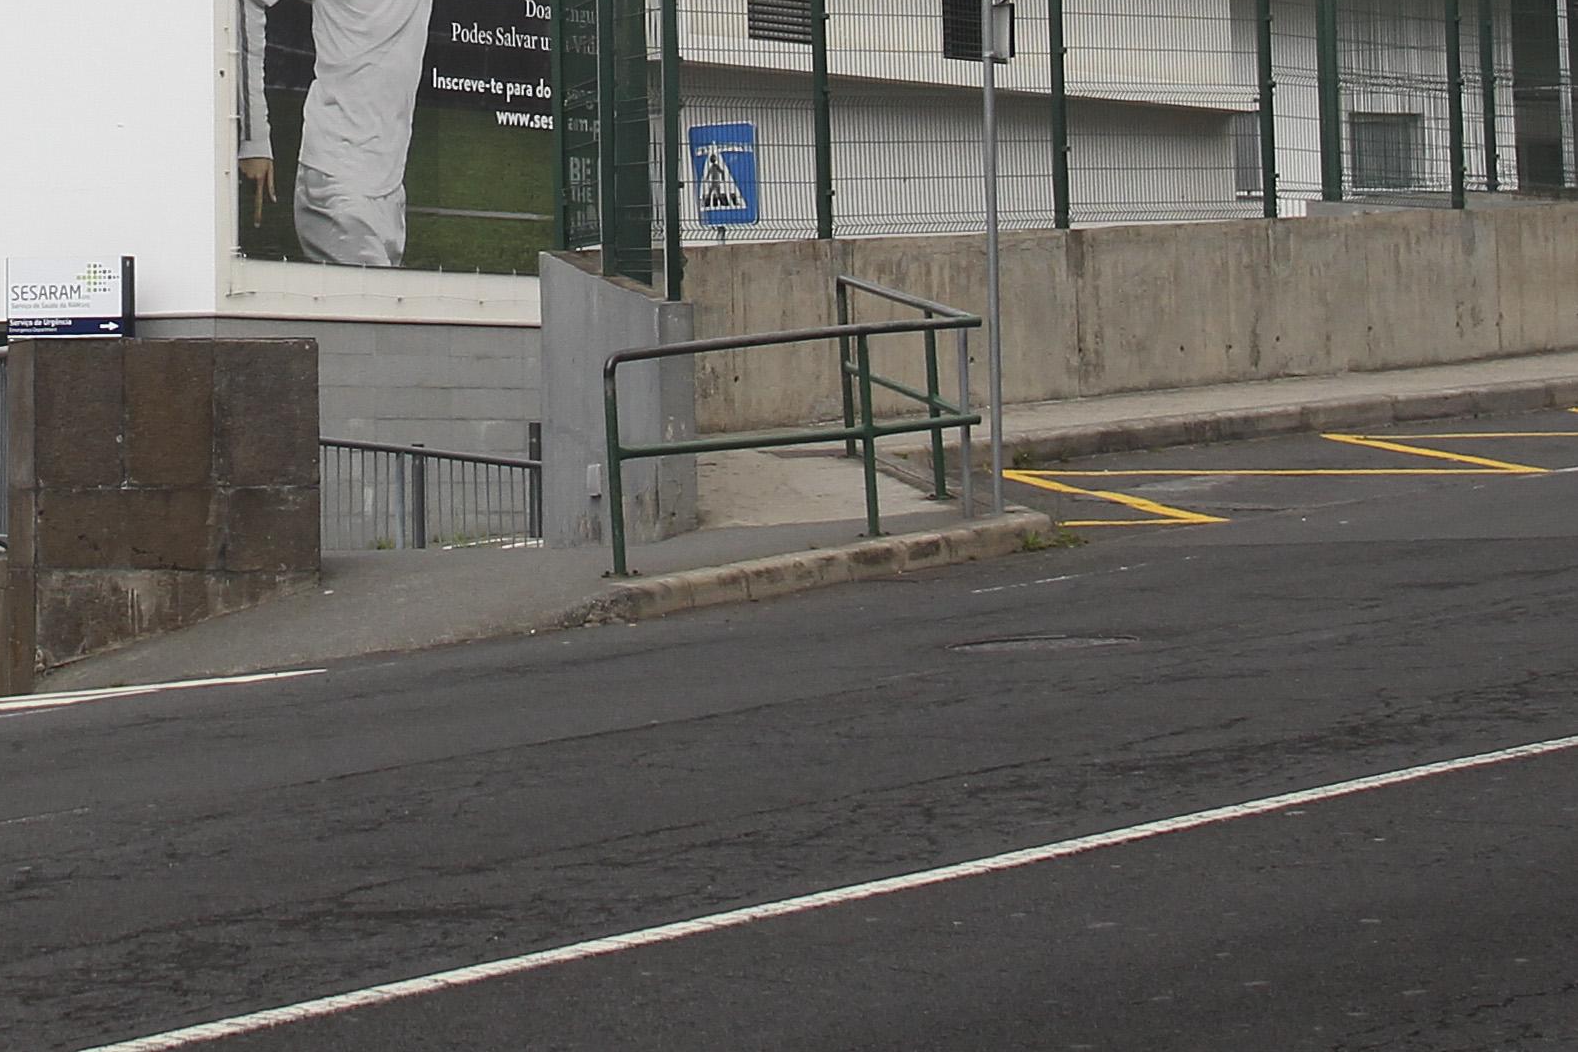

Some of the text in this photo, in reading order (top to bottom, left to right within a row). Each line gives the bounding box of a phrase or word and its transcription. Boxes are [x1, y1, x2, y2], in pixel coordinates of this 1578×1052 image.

[525, 0, 552, 20] Doa
[451, 22, 492, 45] Podes
[495, 26, 540, 50] Salvar
[432, 67, 503, 95] Inscreve-te
[506, 82, 533, 103] para
[11, 284, 81, 301] SESARAM
[9, 319, 33, 327] Serviço
[43, 318, 72, 327] Urgência
